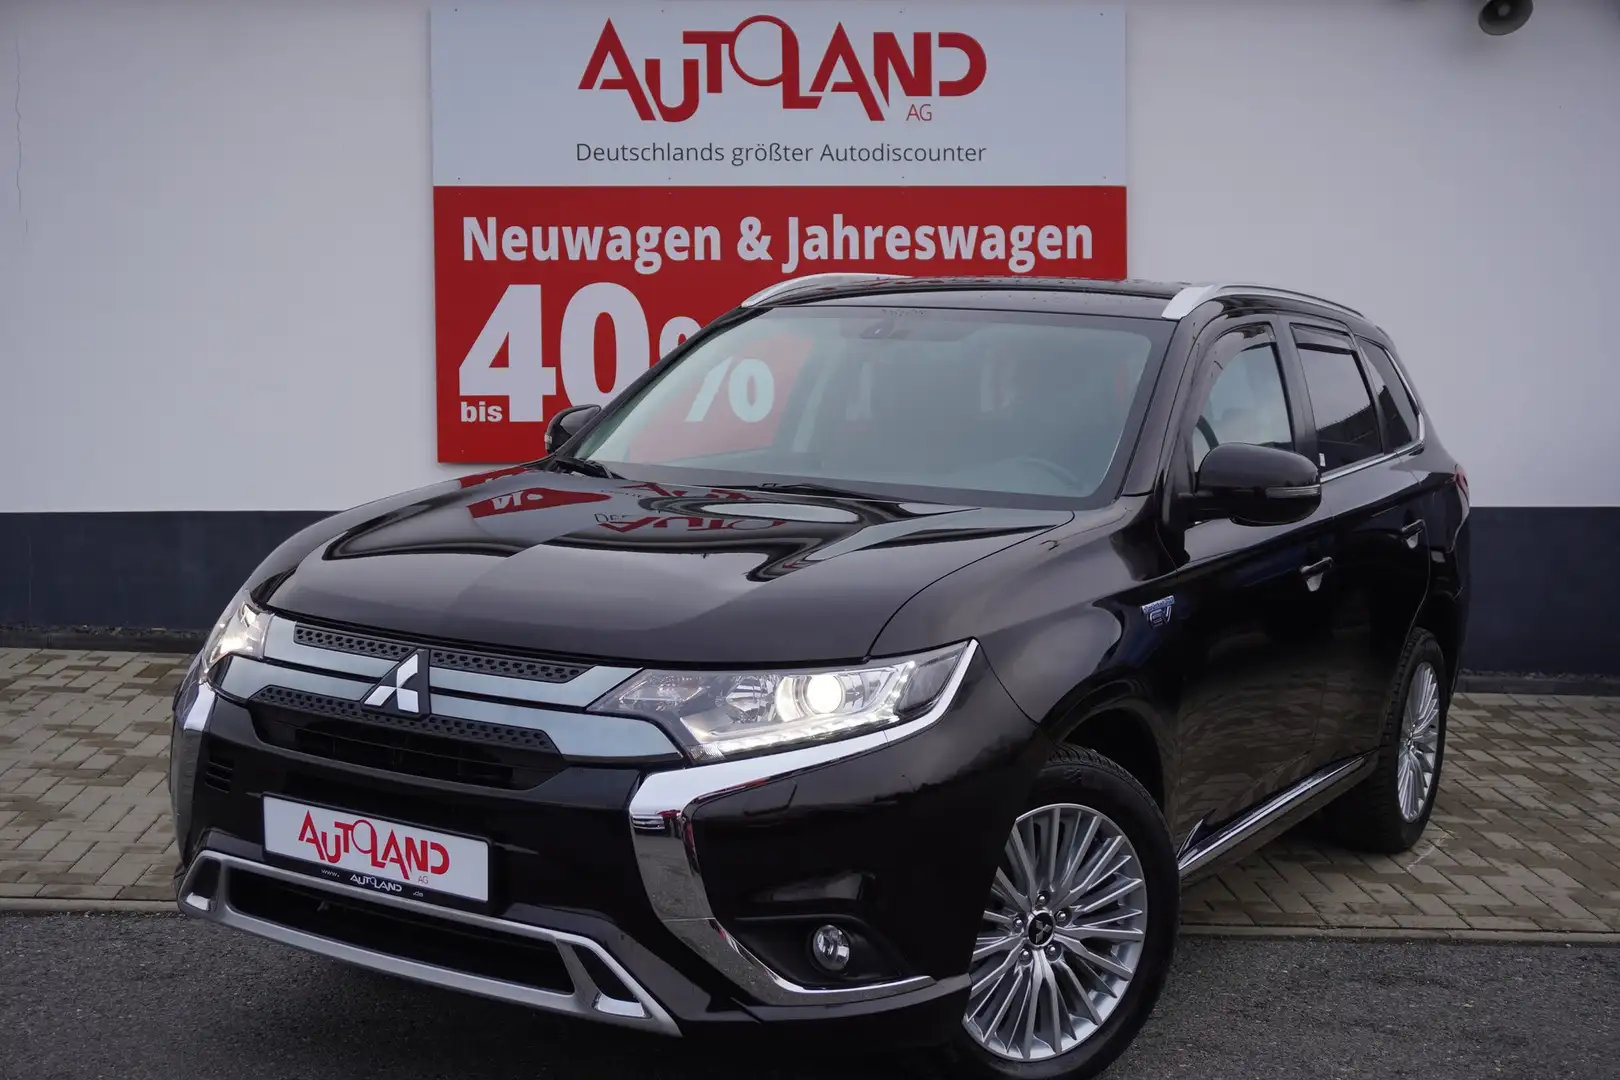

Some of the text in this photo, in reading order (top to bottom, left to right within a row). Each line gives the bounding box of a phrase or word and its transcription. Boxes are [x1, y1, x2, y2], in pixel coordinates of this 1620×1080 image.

[578, 15, 987, 122] AUTOLAND
[906, 104, 932, 121] AG
[576, 142, 987, 167] Deutschlands größter Autodiscounter
[463, 213, 1093, 275] Neuwagen & Jahreswagen
[460, 402, 503, 423] bis
[298, 810, 450, 880] AUTOLAND
[350, 873, 403, 892] AUTOLAND
[417, 876, 429, 885] AG
